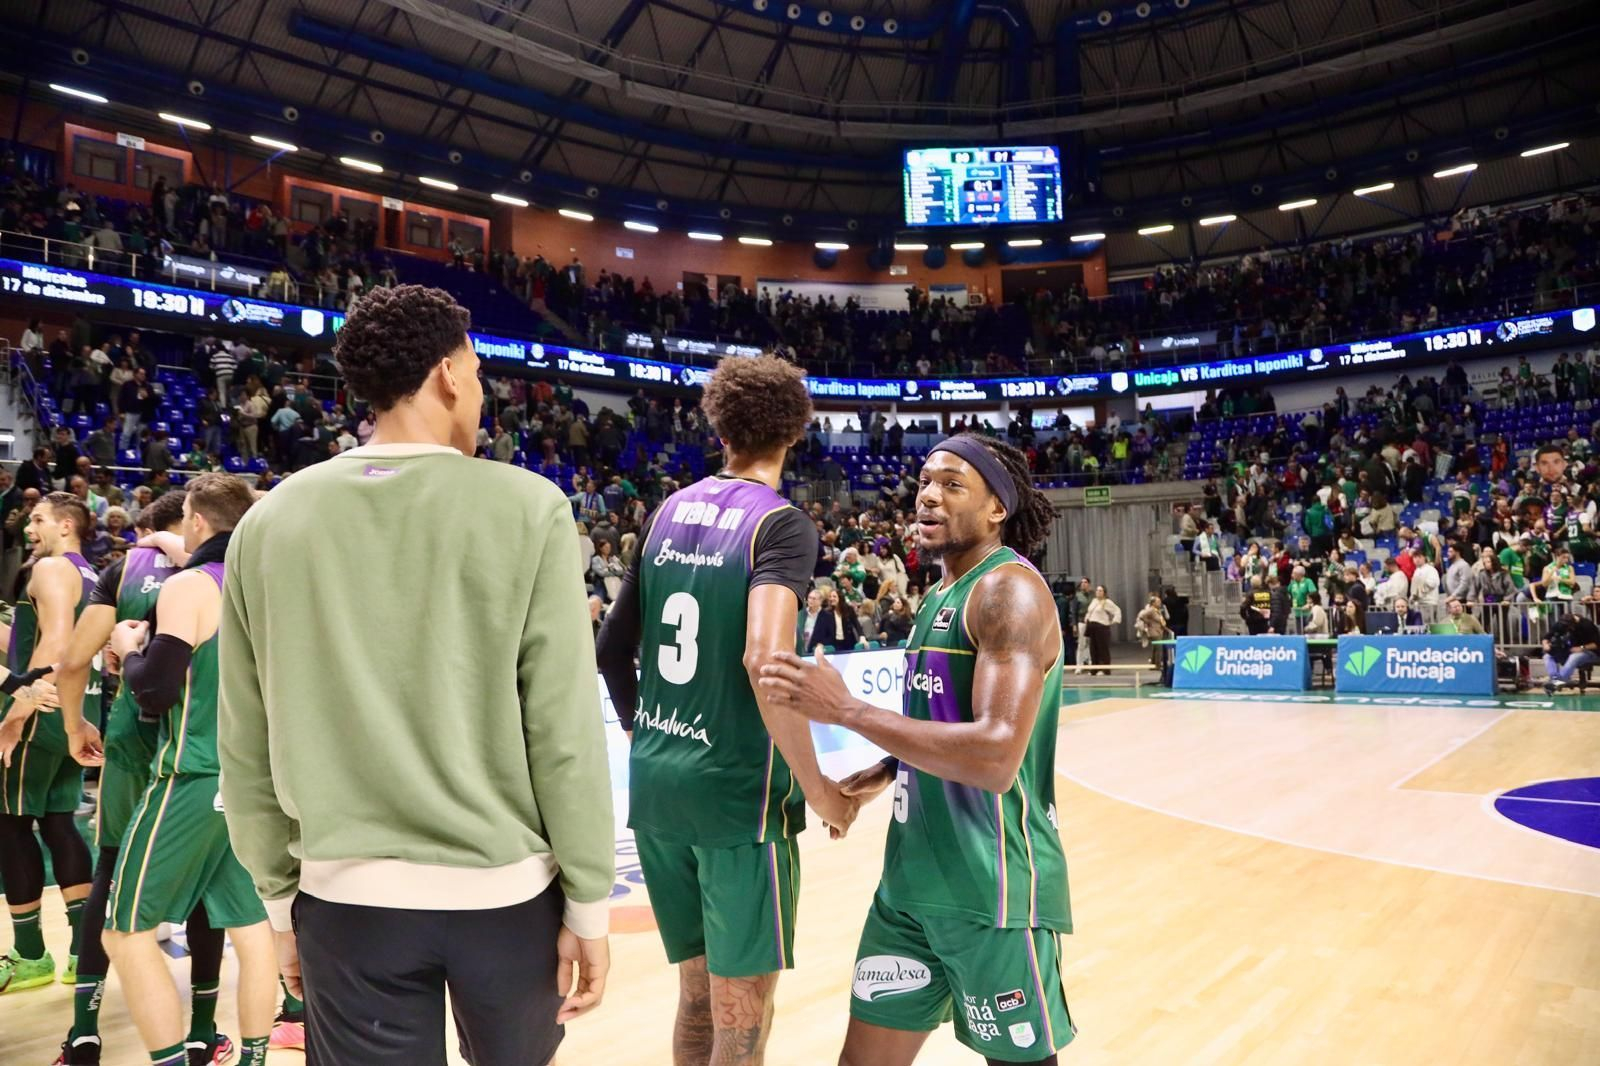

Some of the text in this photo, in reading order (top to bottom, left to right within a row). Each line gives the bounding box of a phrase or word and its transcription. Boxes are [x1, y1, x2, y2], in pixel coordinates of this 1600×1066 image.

[2, 276, 21, 292] 17
[1339, 355, 1351, 365] 17
[1135, 370, 1179, 386] Unicaja
[1181, 367, 1198, 382] VS
[1200, 361, 1252, 379] Karditsa
[810, 380, 856, 395] Karditsa
[657, 591, 700, 685] 3
[1216, 646, 1297, 662] Fundación
[1386, 648, 1484, 664] Fundación
[1215, 661, 1273, 679] Unicaja
[1386, 662, 1456, 683] Unicaja
[633, 696, 713, 747] Andalucía
[853, 959, 927, 986] famadesa
[1000, 998, 1019, 1009] acb
